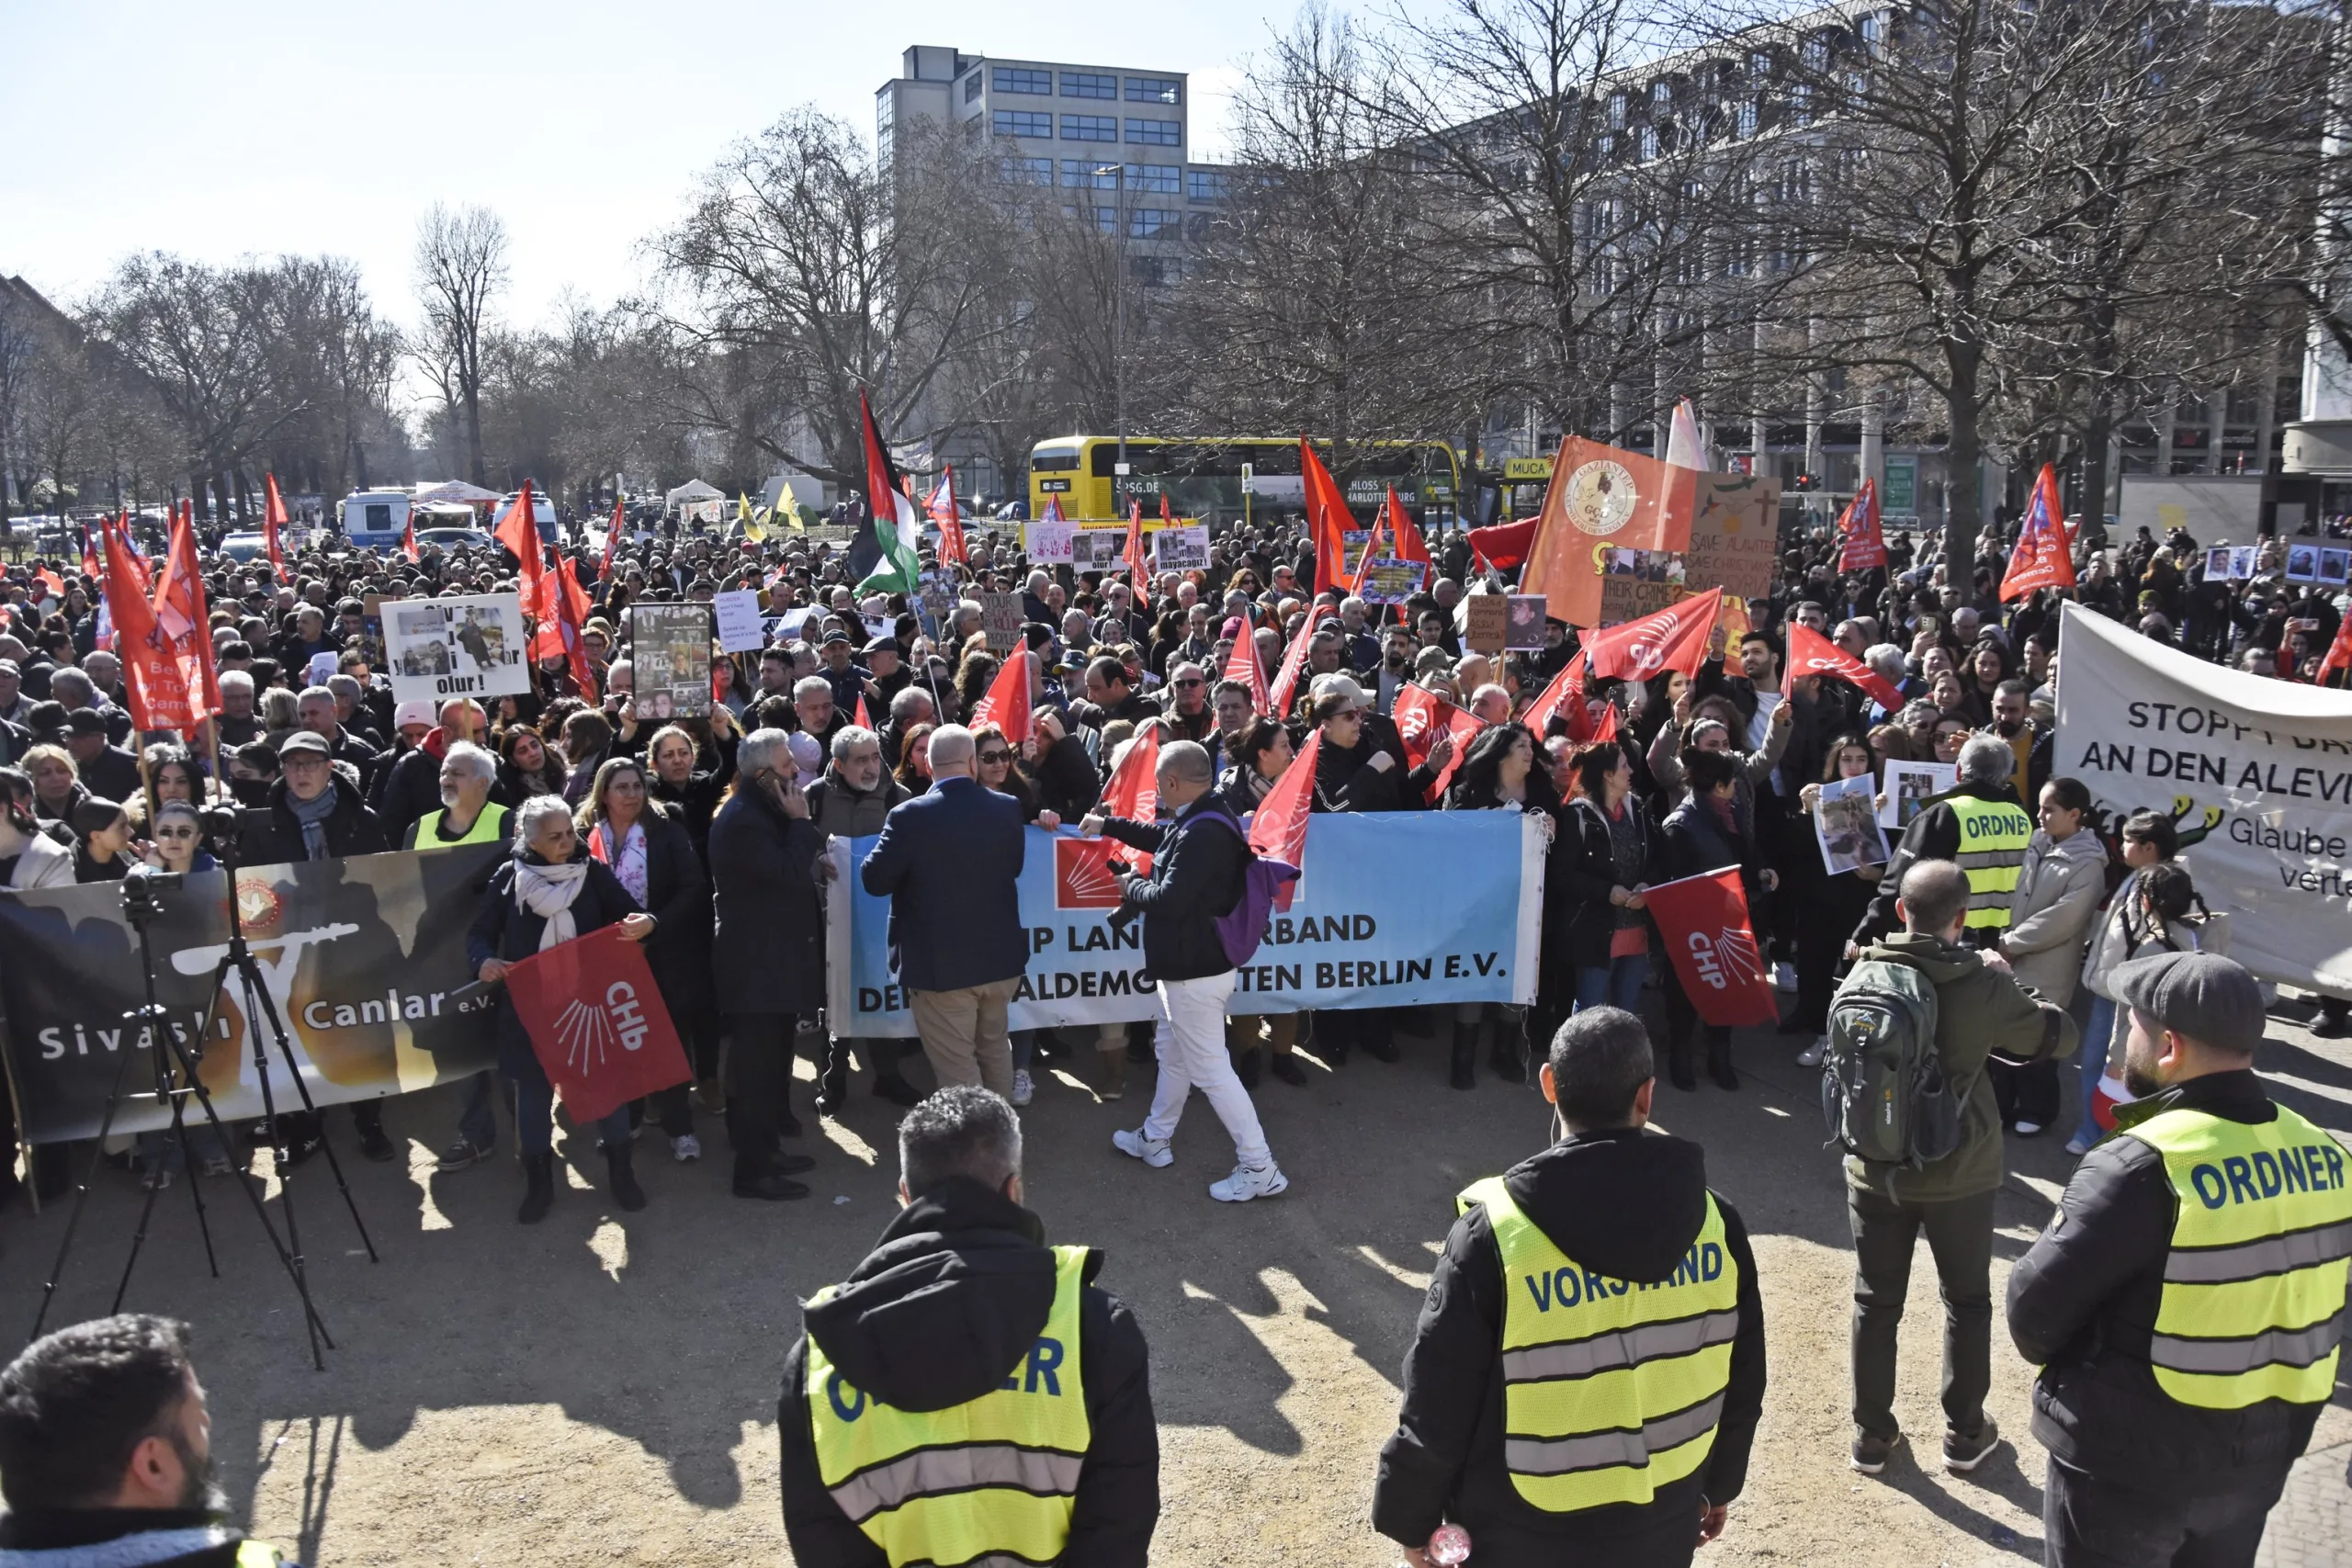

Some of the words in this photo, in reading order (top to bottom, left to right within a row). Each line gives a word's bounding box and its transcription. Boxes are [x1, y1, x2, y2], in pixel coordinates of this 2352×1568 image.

[1348, 480, 1379, 491] HLOSS
[1690, 533, 1721, 552] SAVE
[1603, 579, 1633, 599] THEIR
[1685, 572, 1721, 591] SAVE
[983, 594, 1014, 608] YOUR
[436, 675, 474, 694] olur
[478, 674, 484, 691] !
[2080, 741, 2135, 773] AN
[2146, 748, 2227, 786] DEN
[2229, 818, 2346, 859] Glaube
[1316, 957, 1432, 989] BERLIN
[1444, 952, 1507, 978] E.V.
[1689, 931, 1727, 989] CHP
[302, 987, 447, 1032] Canlar
[458, 994, 495, 1013] e.V.
[2191, 1145, 2345, 1210] ORDNER
